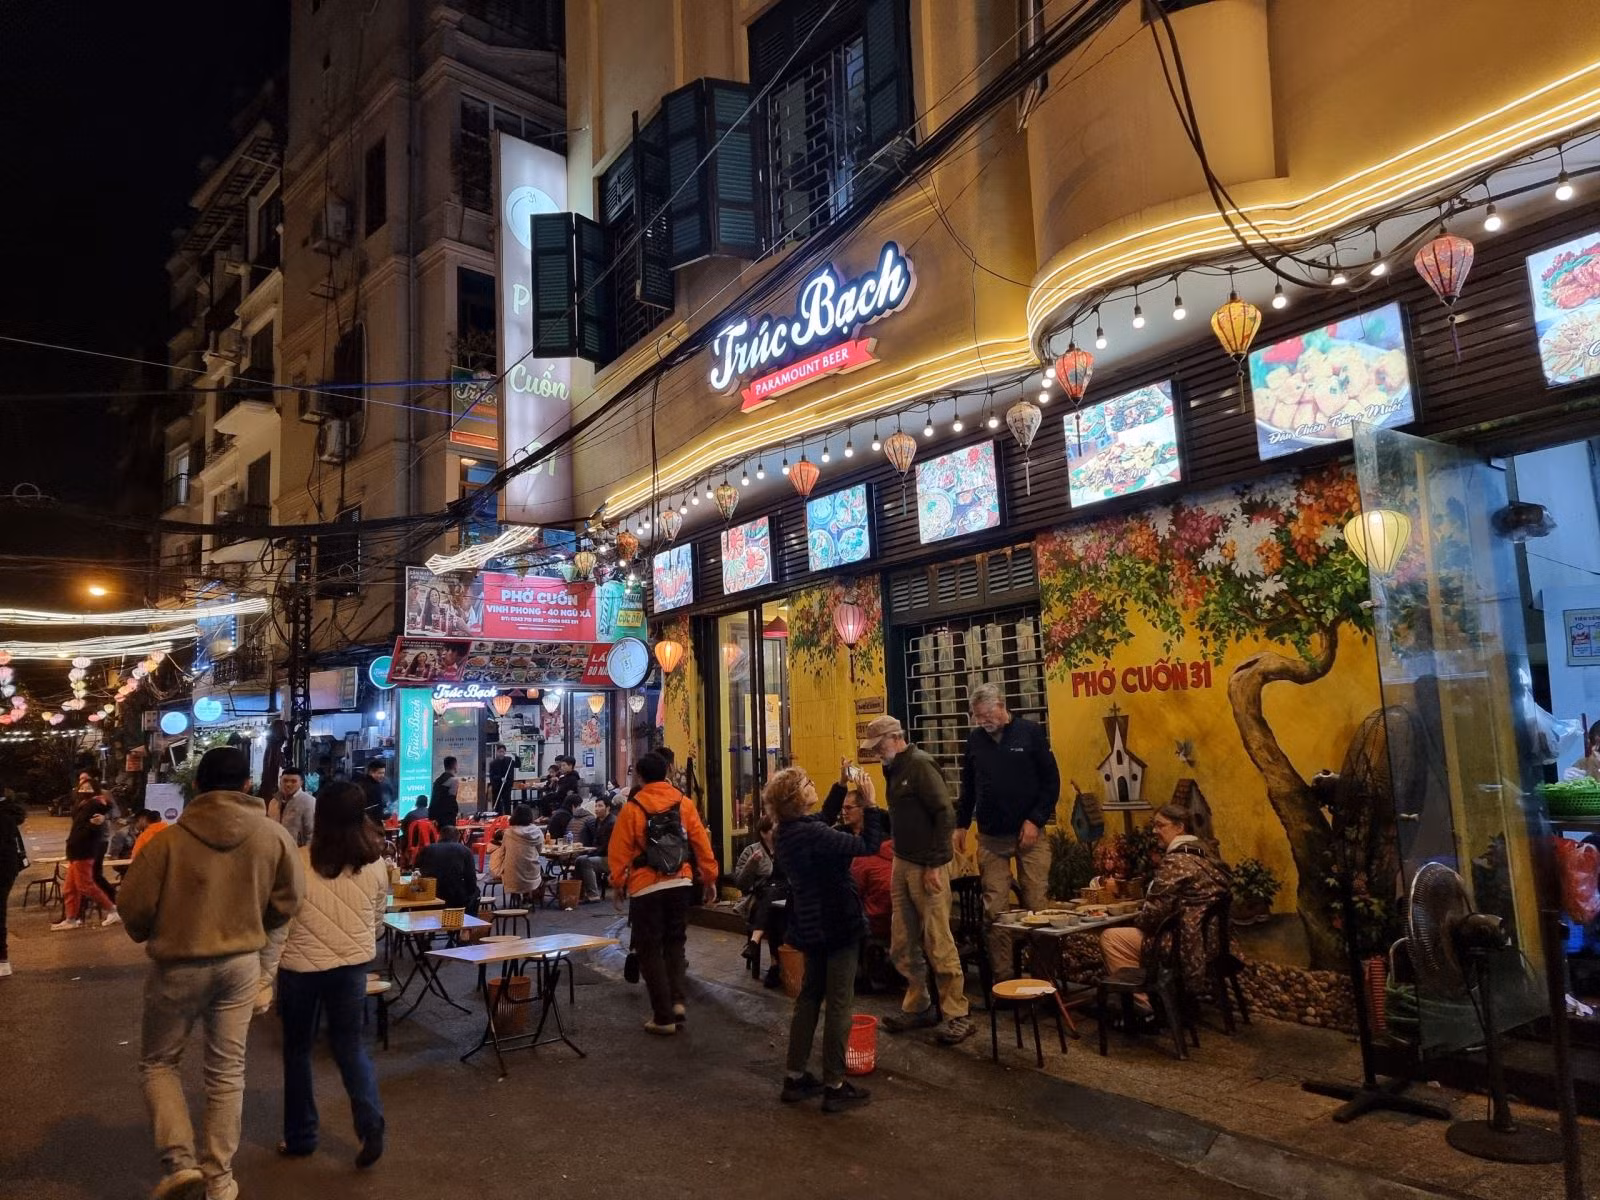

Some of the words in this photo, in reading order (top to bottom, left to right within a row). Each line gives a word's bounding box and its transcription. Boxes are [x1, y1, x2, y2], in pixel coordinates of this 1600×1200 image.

[710, 319, 788, 390] Trúc
[791, 249, 905, 346] Bạch
[510, 364, 569, 401] Cuốn
[755, 359, 820, 396] PARAMOUNT
[822, 347, 850, 368] BEER
[486, 605, 508, 613] VINH
[510, 606, 541, 615] PHONG
[501, 589, 534, 603] PHỞ
[537, 588, 578, 606] CUỐN
[434, 684, 464, 699] Trúc
[463, 684, 498, 699] Bạch
[1071, 660, 1117, 698] PHỞ
[1121, 656, 1188, 693] CUỐN
[1190, 660, 1212, 689] 31
